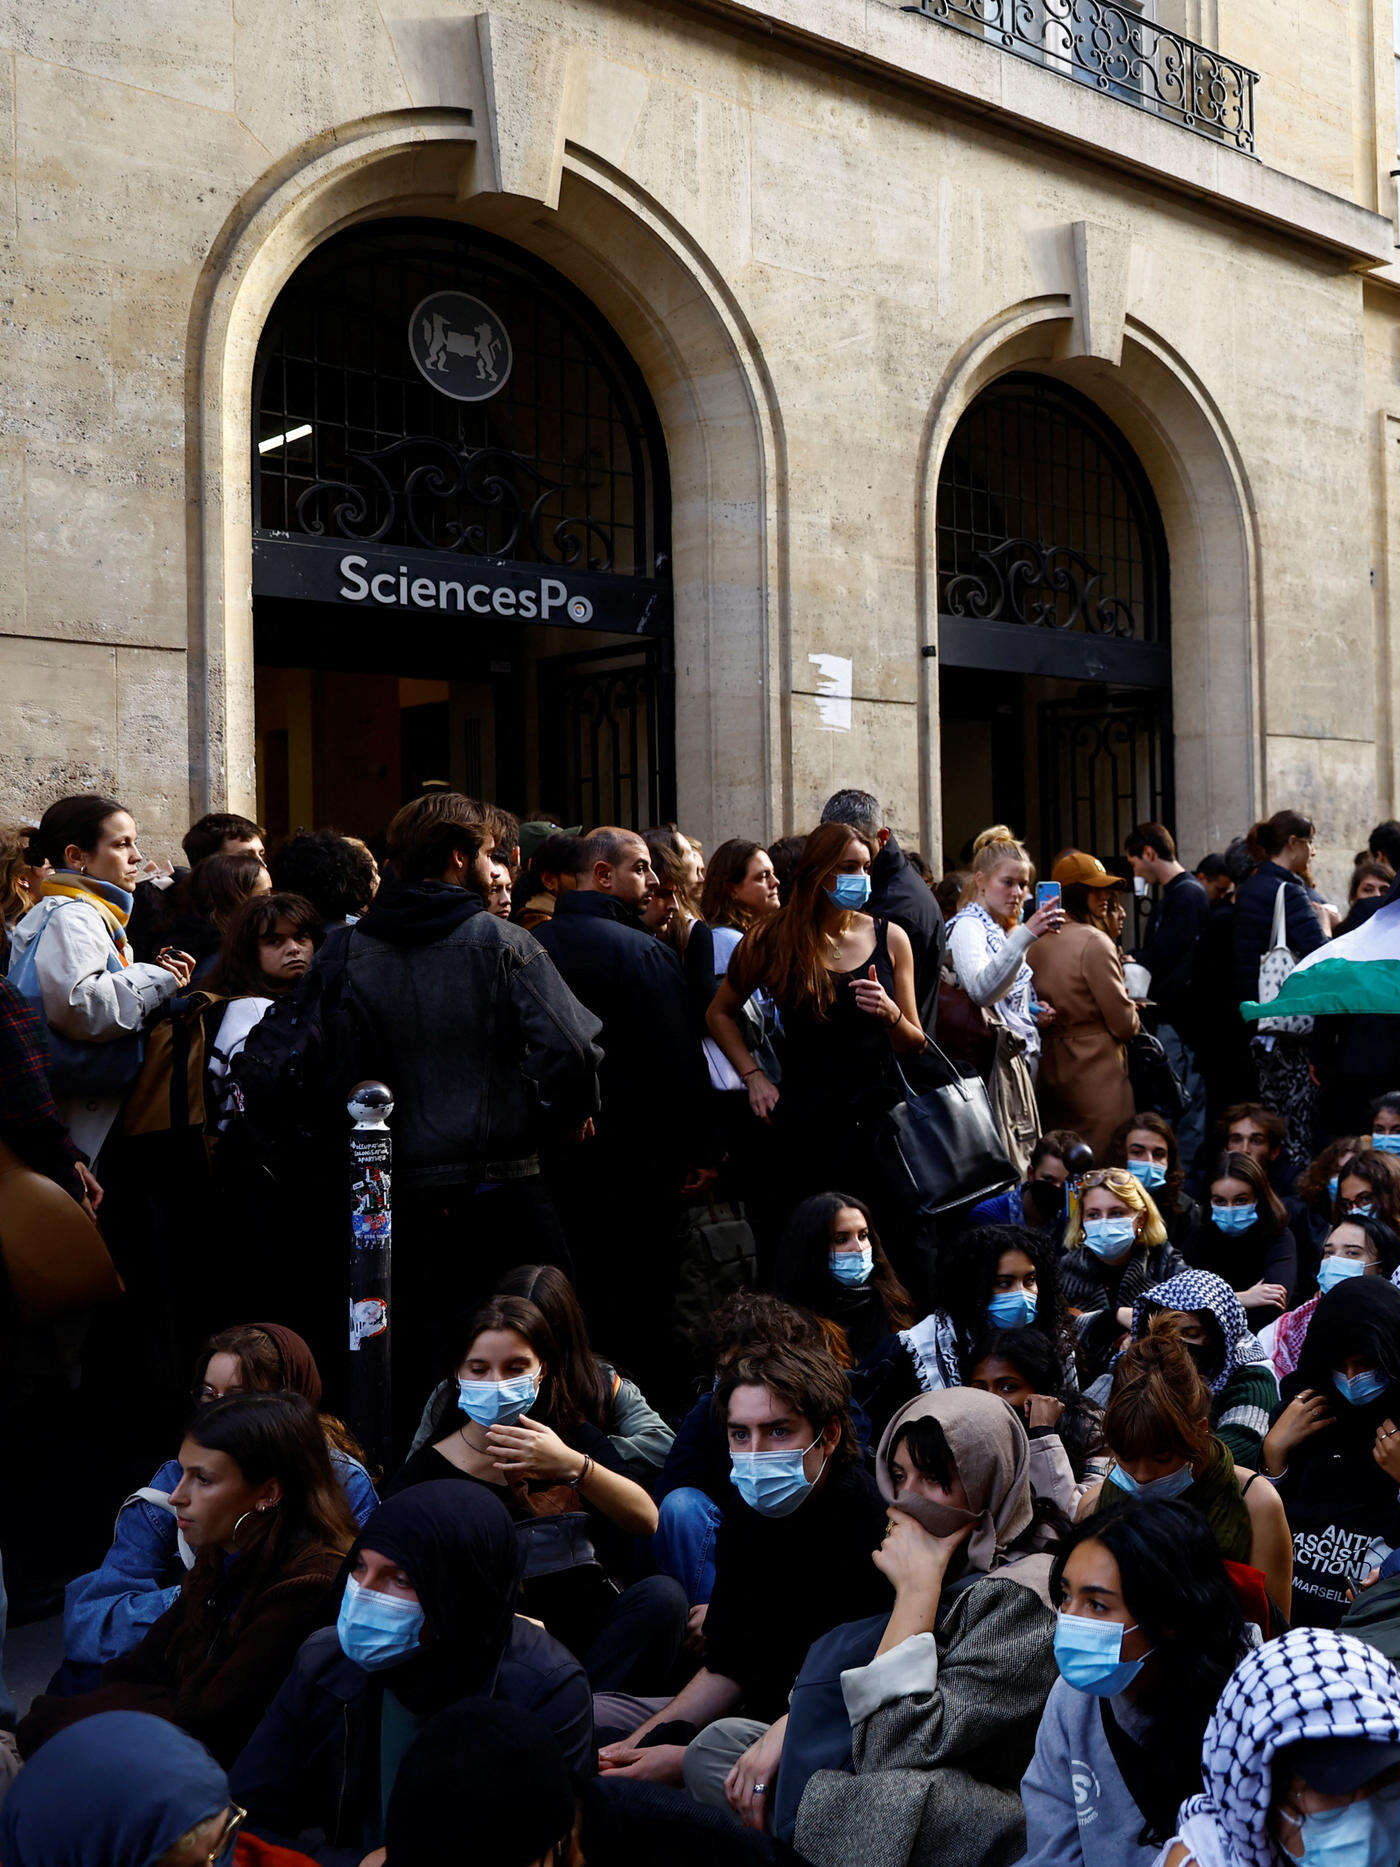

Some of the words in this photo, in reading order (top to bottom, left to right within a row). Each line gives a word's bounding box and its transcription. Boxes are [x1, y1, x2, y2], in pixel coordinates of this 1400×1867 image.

[339, 554, 594, 624] SciencesPo
[1293, 1532, 1367, 1561] ASCIST
[1293, 1545, 1361, 1580] CTION
[1292, 1576, 1352, 1604] MARSEILL
